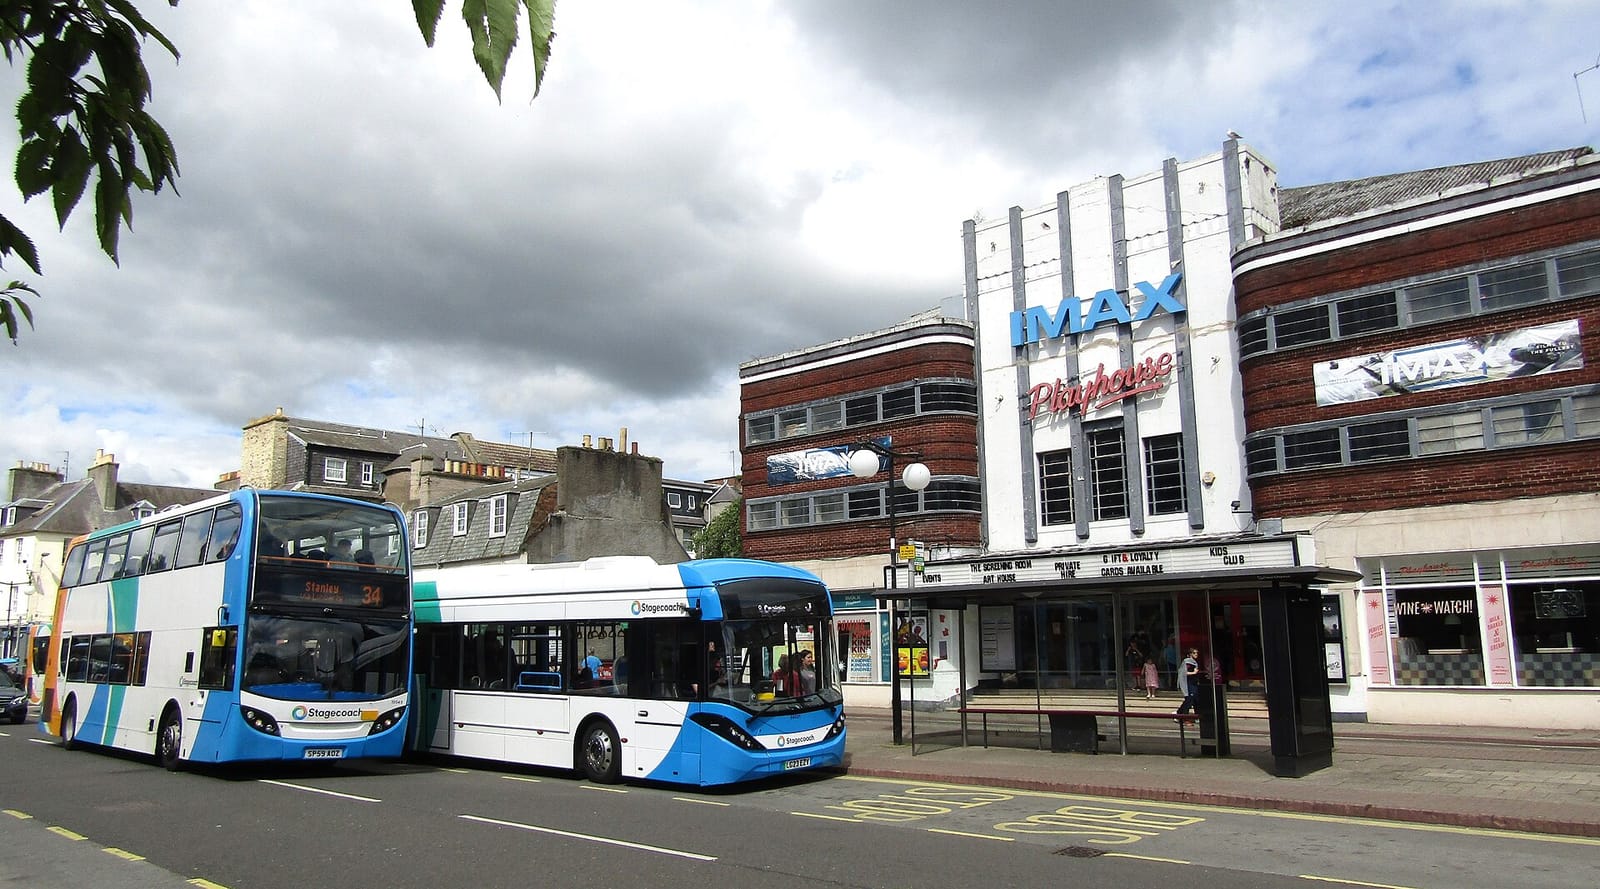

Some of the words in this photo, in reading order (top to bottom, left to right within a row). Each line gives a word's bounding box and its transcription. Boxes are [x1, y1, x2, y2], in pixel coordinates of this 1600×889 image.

[1010, 272, 1187, 347] IMAX
[1545, 344, 1575, 353] FULLEST
[1379, 342, 1506, 385] IMAX
[1027, 352, 1173, 420] Playhouse
[1130, 551, 1159, 562] LOYALTY
[1209, 546, 1228, 557] KIDS
[970, 562, 982, 572] THE
[1014, 559, 1032, 569] ROOM
[1054, 561, 1081, 572] PRIVATE
[1223, 555, 1245, 566] CLUB
[1060, 570, 1076, 579] HIRE
[1100, 565, 1124, 577] CARDS
[1126, 564, 1164, 575] AVAILABLE
[982, 574, 995, 584] ART
[996, 573, 1016, 583] HOUSE
[304, 581, 339, 593] Stanley
[362, 586, 382, 606] 34
[641, 602, 681, 614] Stagecoach
[1394, 601, 1420, 616] WINE
[1433, 600, 1473, 614] WATCH!
[786, 735, 815, 745] Stagecoach
[993, 805, 1206, 844] BUS
